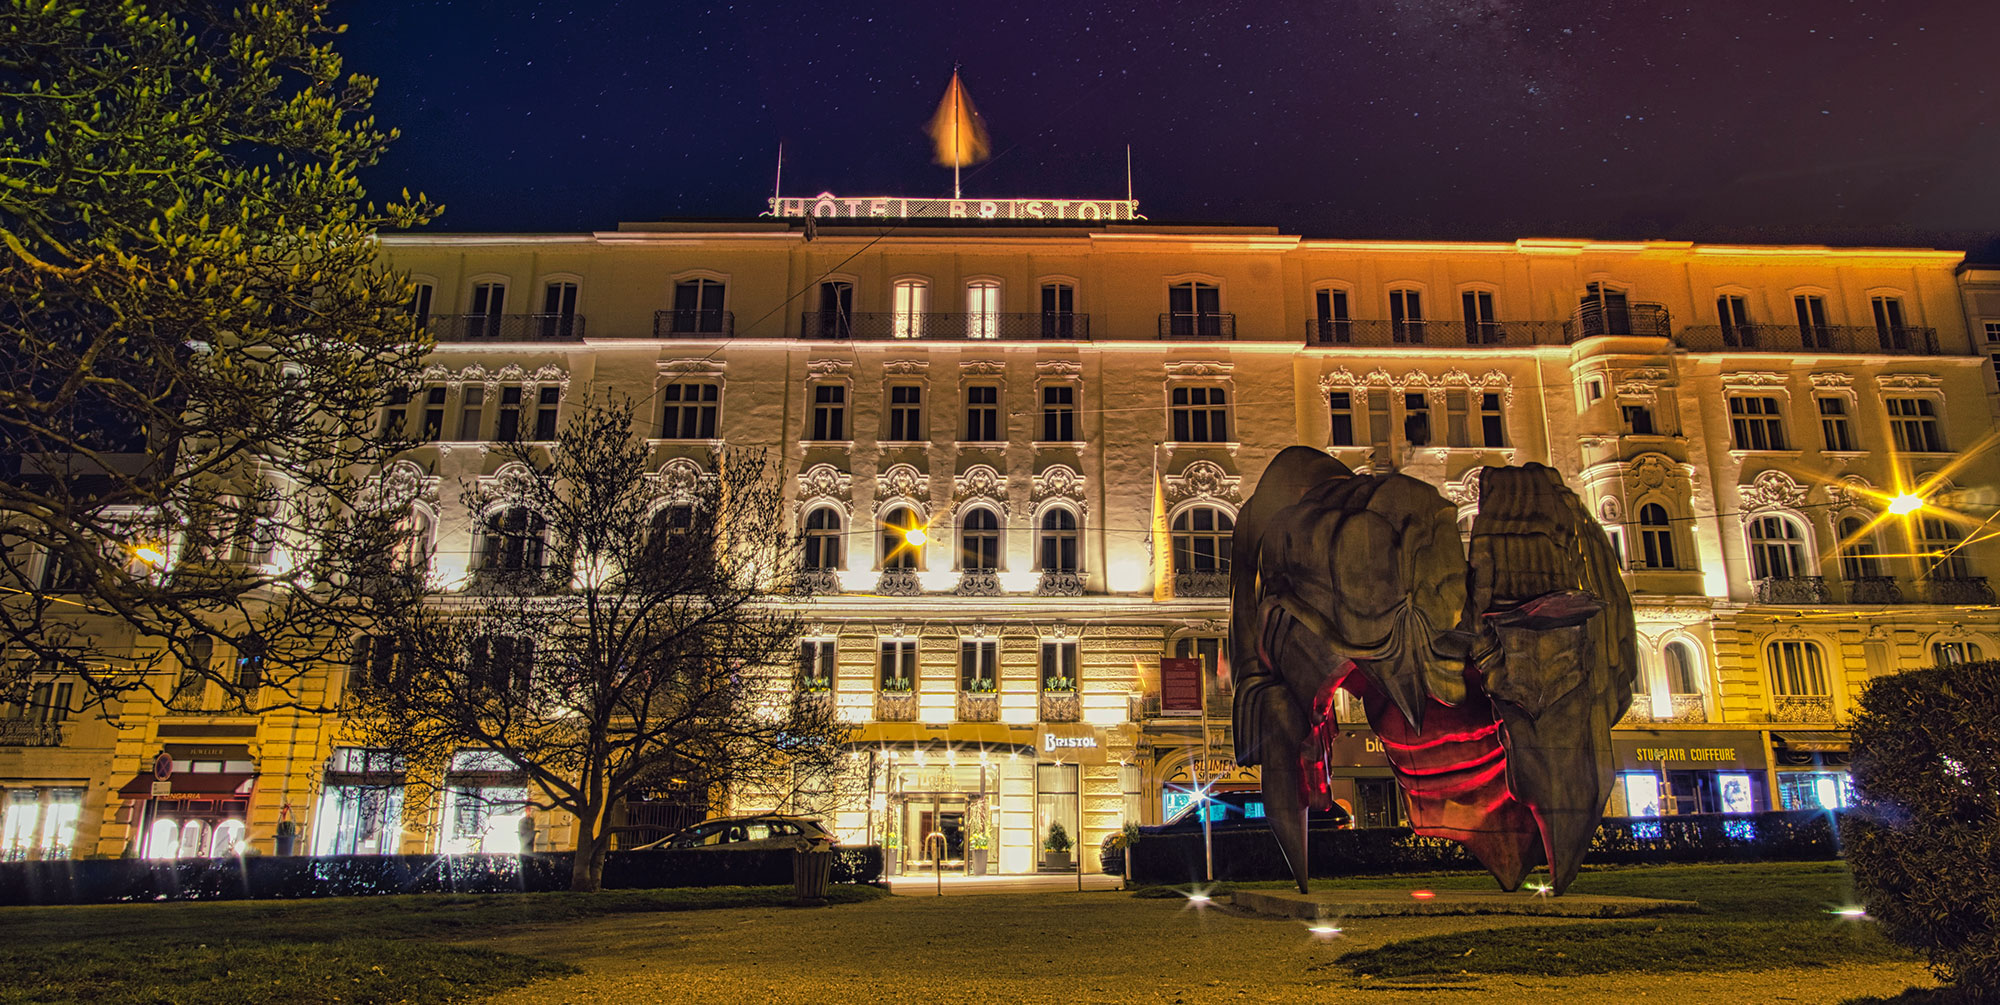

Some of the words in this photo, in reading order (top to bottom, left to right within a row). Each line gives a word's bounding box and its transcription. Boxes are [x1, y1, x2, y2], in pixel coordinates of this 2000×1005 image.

[950, 201, 1117, 220] BRISTOL
[1690, 748, 1736, 761] COIFFEURE
[164, 792, 200, 800] NGARIA
